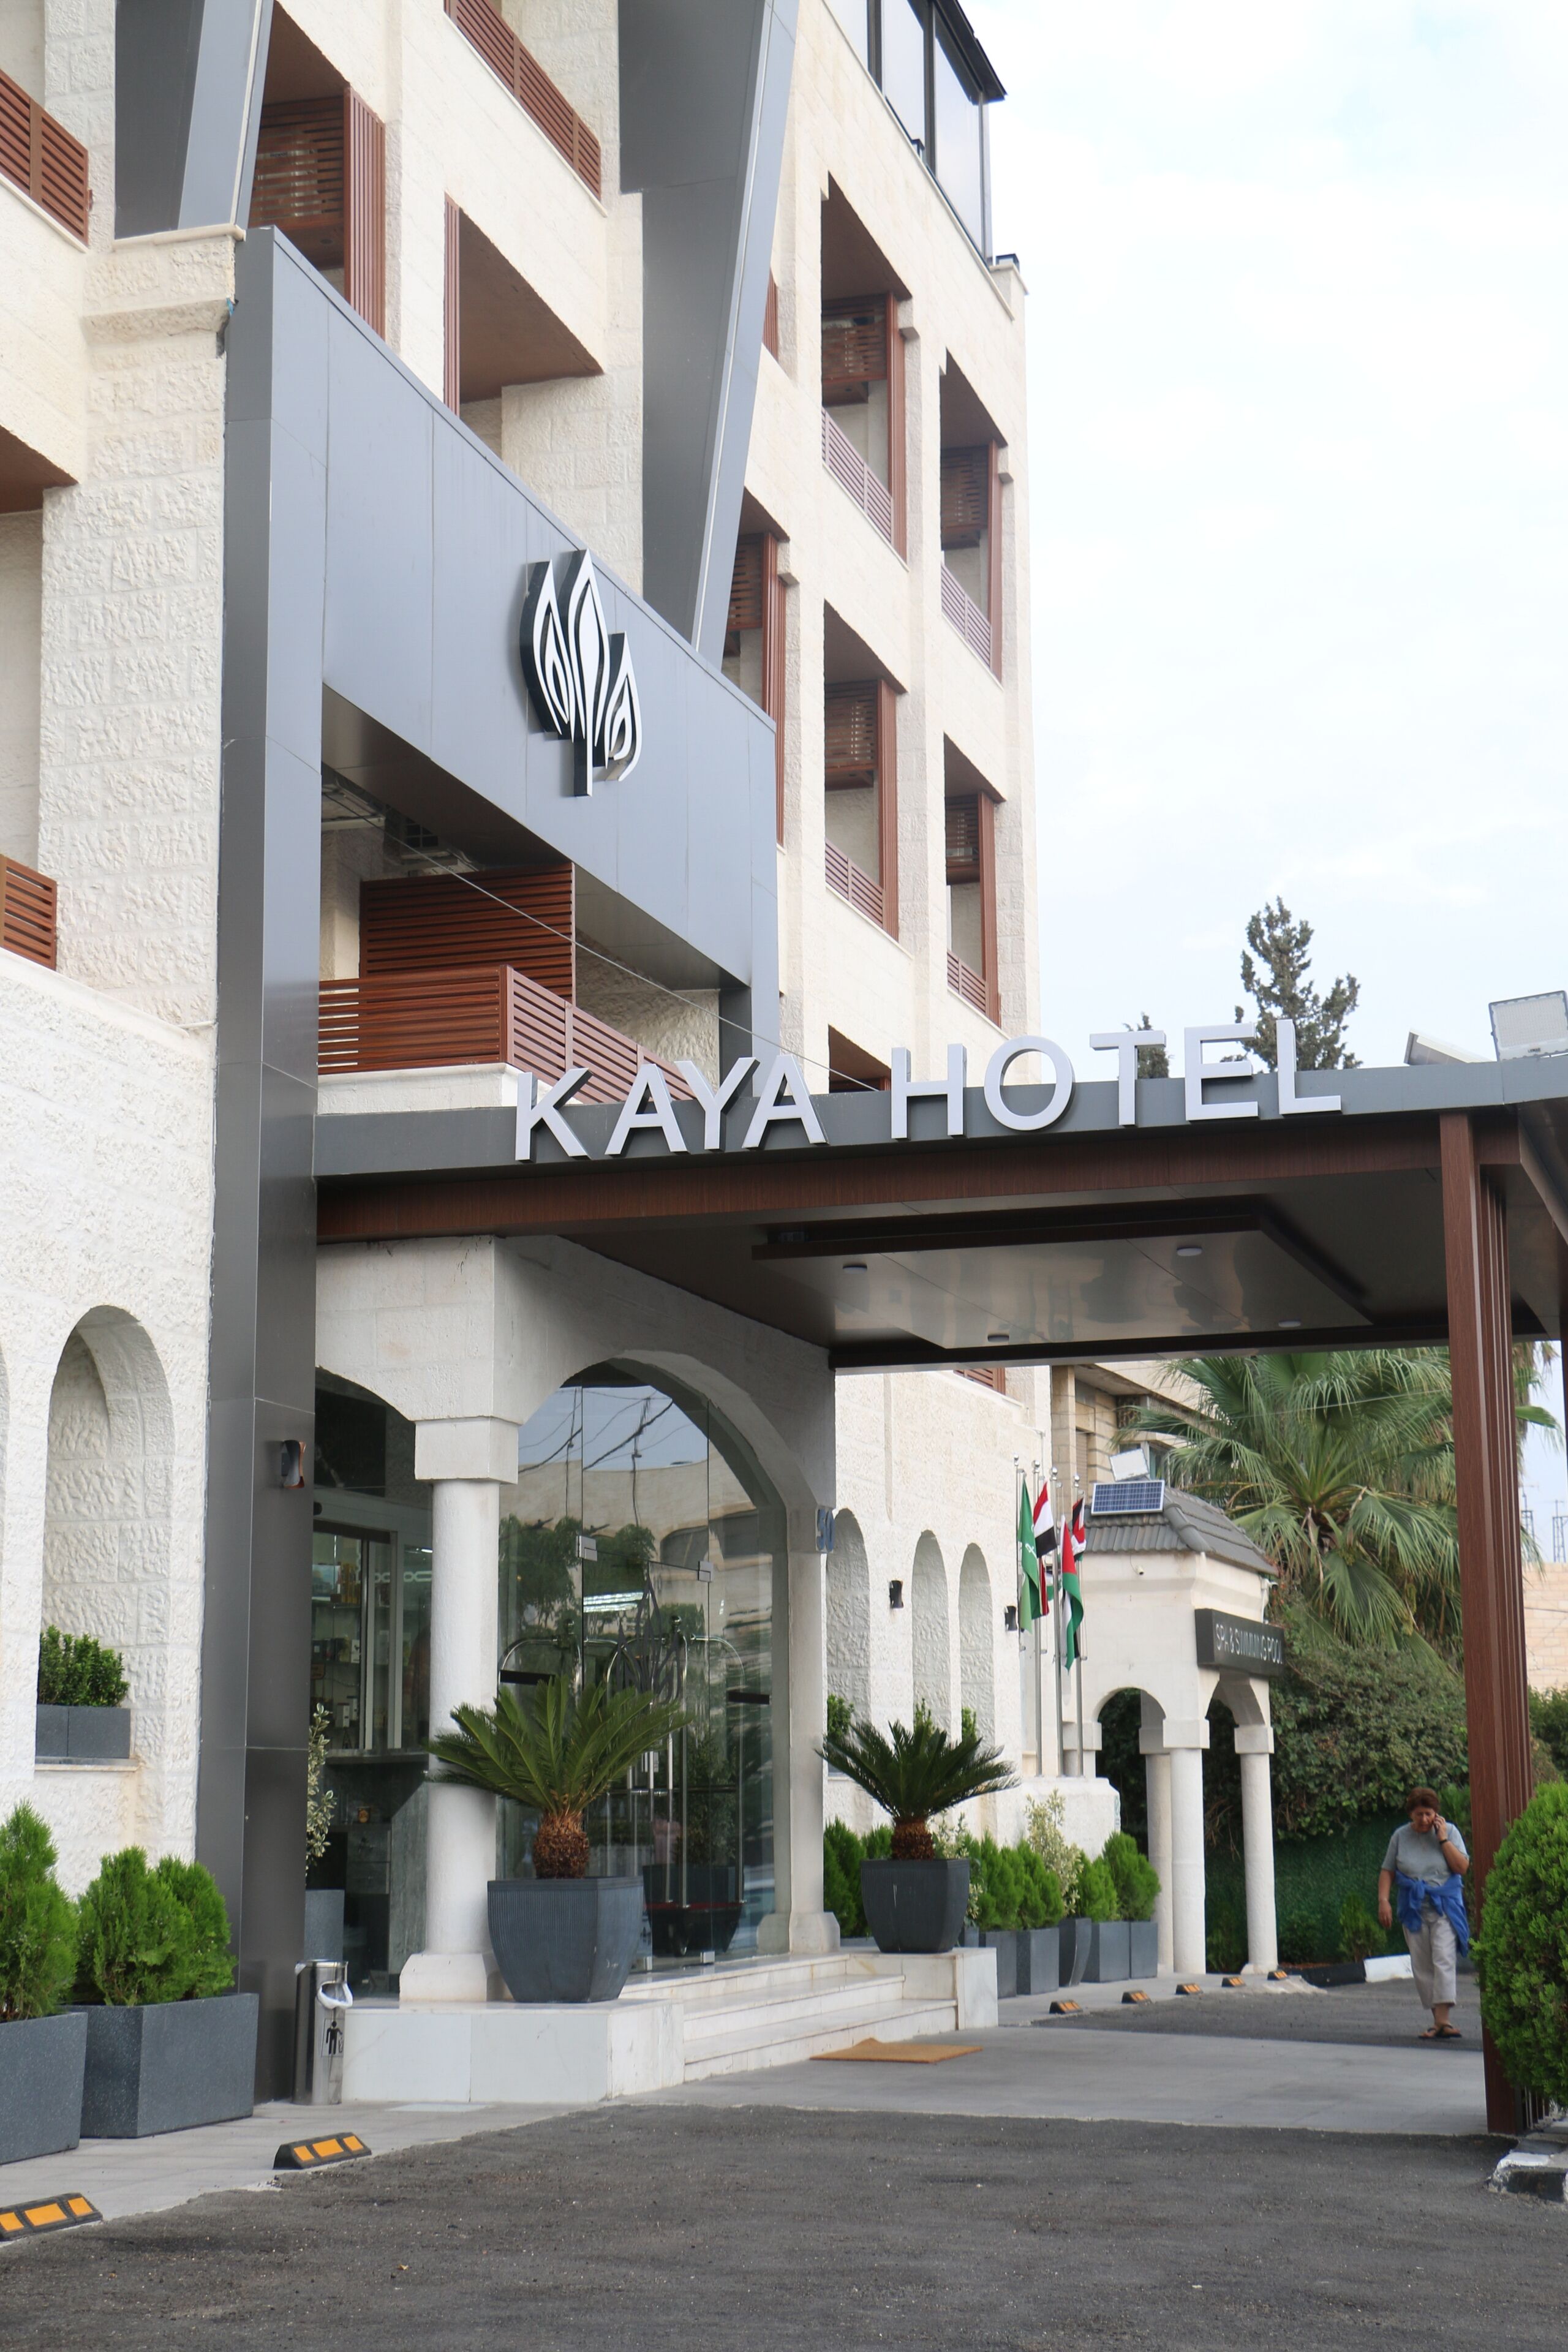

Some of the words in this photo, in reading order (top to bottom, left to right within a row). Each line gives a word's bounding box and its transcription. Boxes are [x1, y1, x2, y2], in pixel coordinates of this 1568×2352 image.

[515, 1055, 830, 1161] KAYA
[891, 1019, 1342, 1140] HOTEL
[1216, 1623, 1230, 1653] SPA
[1229, 1627, 1235, 1654] &
[1234, 1627, 1267, 1661] SWIMMING
[1267, 1636, 1283, 1664] POOL
